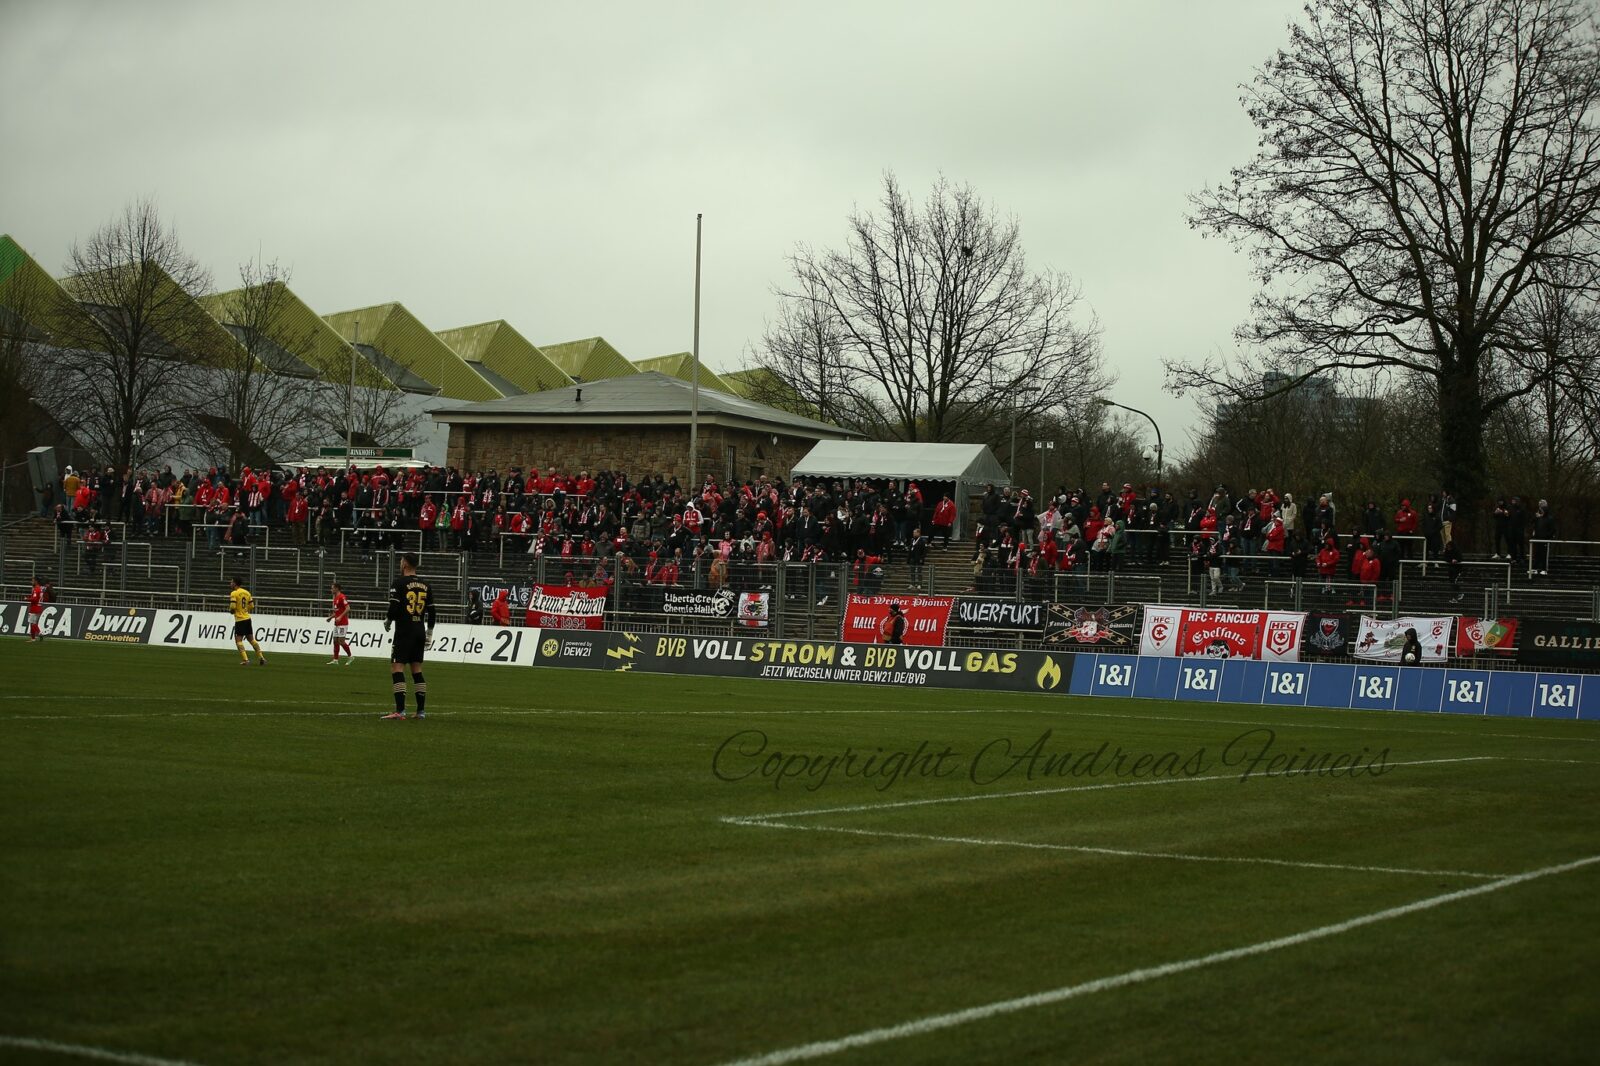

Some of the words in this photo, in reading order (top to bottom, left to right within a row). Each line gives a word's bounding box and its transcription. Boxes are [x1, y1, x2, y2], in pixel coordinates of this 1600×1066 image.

[241, 597, 247, 609] 6
[405, 591, 427, 616] 35
[530, 586, 607, 615] Leuna-Löwen
[721, 590, 736, 600] HFC
[87, 607, 148, 633] bwin
[663, 603, 693, 614] Chemie
[959, 602, 1042, 625] QUERFURT
[1153, 616, 1170, 624] HFC
[1188, 611, 1208, 623] HFC
[1214, 613, 1260, 625] FANCLUB
[13, 605, 72, 637] LGA
[163, 613, 193, 644] 21
[198, 624, 227, 640] WIR
[853, 616, 876, 630] HALLE
[913, 619, 937, 632] LUJA
[1271, 622, 1297, 630] HFC
[84, 632, 140, 643] Sportwetten
[490, 630, 523, 662] 21
[1192, 626, 1247, 646] Edelfans
[563, 647, 592, 657] DEW21
[656, 637, 687, 658] BVB
[692, 639, 747, 661] VOLL
[750, 642, 836, 665] STROM
[840, 646, 857, 667] &
[864, 647, 897, 669] BVB
[903, 649, 962, 672] VOLL
[966, 651, 1018, 674] GAS
[760, 665, 785, 678] JETZT
[786, 666, 831, 680] WECHSELN
[833, 668, 861, 681] UNTER
[863, 669, 926, 684] DEW21.DE/BVB
[1098, 663, 1132, 687] 1&1
[1183, 667, 1218, 691] 1&1
[1270, 671, 1305, 695] 1&1
[1358, 675, 1393, 699] 1&1
[1448, 679, 1484, 703] 1&1
[1539, 683, 1576, 707] 1&1
